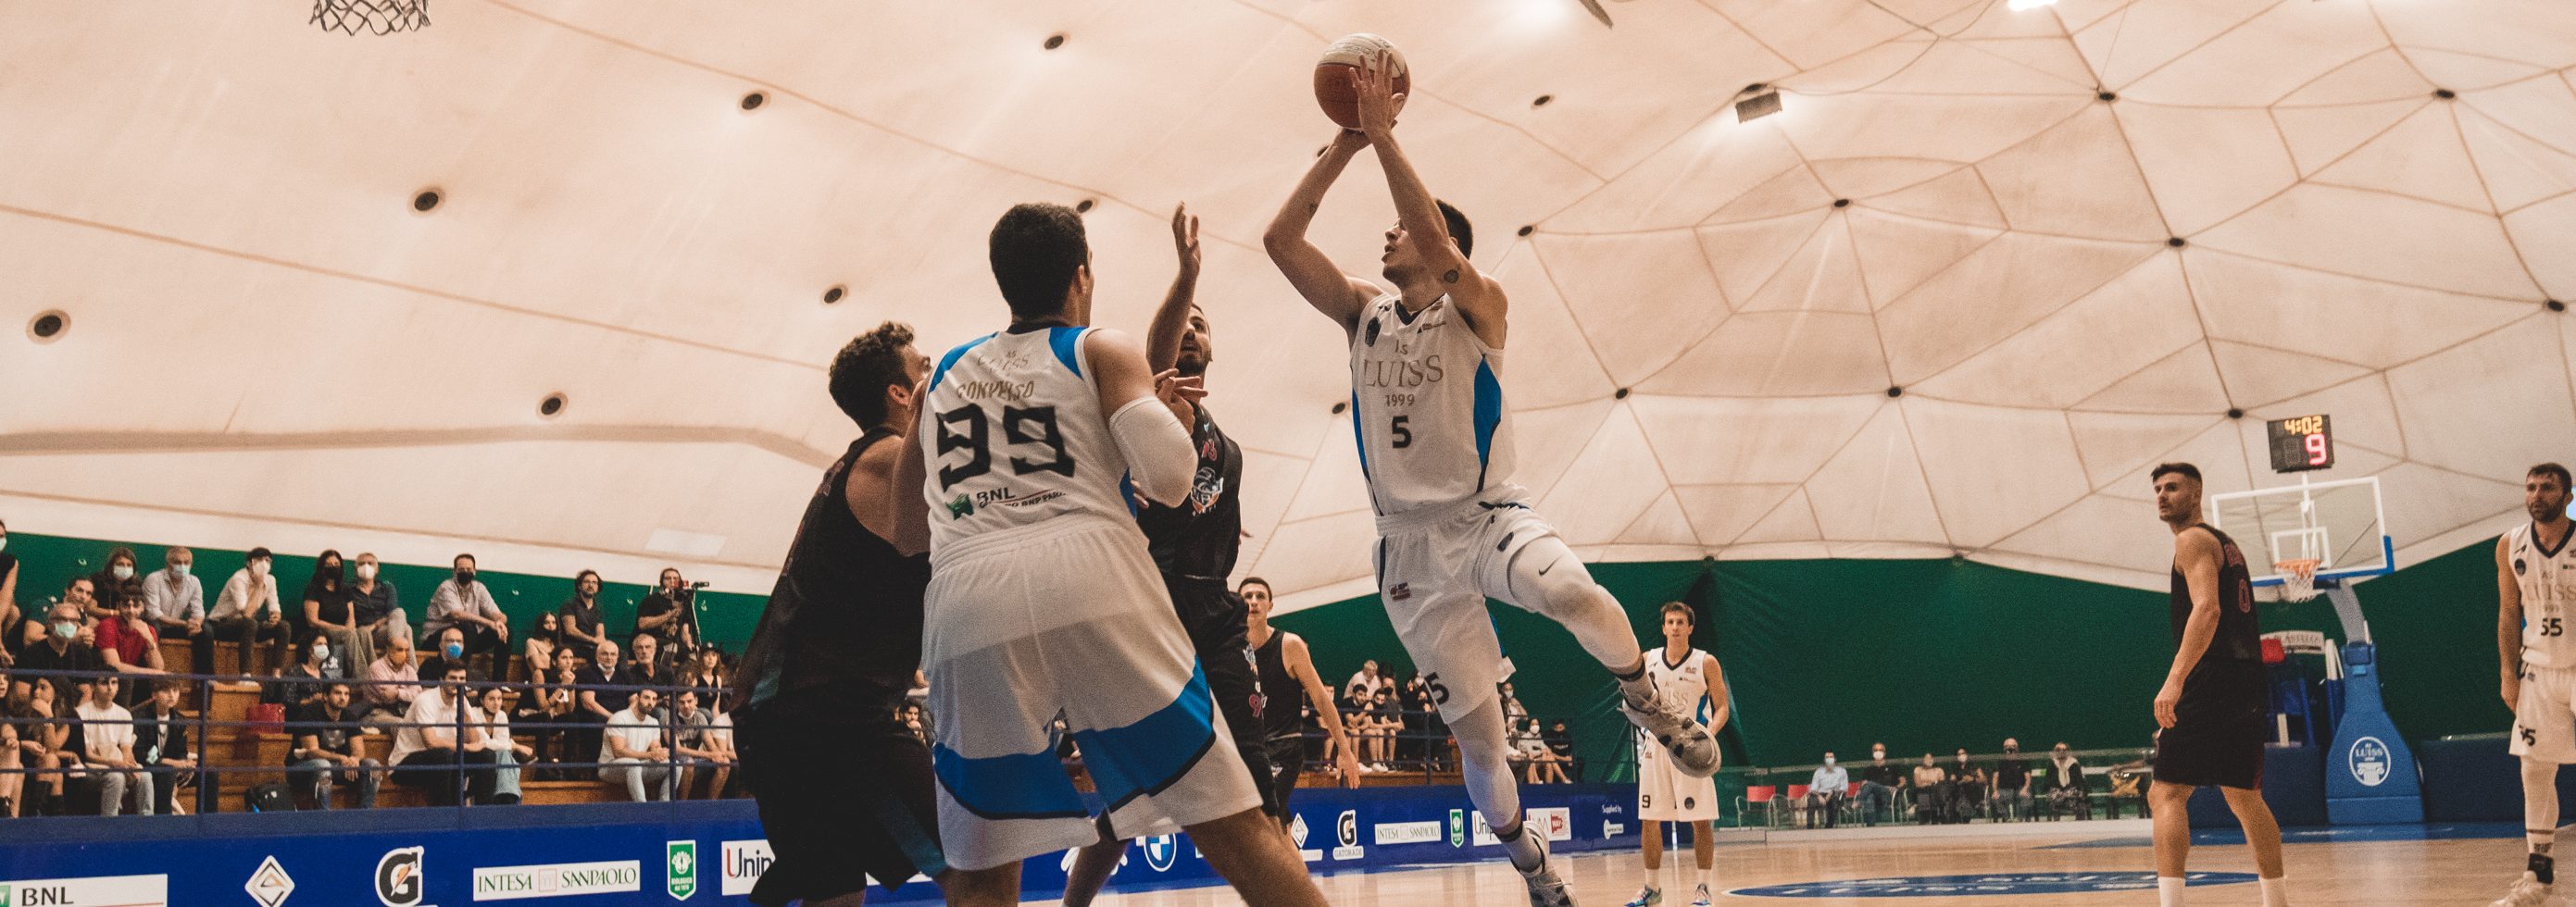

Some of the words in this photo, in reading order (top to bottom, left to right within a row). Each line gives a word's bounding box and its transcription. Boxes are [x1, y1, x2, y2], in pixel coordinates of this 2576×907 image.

[1364, 354, 1444, 388] LUISS
[1385, 393, 1415, 407] 1999
[1392, 415, 1412, 449] 5
[2283, 416, 2323, 435] 4:02
[935, 404, 1075, 493] 99
[2305, 433, 2327, 465] 9
[976, 487, 1017, 508] BNL
[2540, 617, 2564, 637] 55
[1425, 671, 1450, 705] 5
[1642, 794, 1652, 809] 9
[1334, 848, 1362, 858] GATORADE
[478, 873, 533, 893] INTESA
[561, 866, 637, 888] SANPAOLO
[21, 886, 75, 907] BNL
